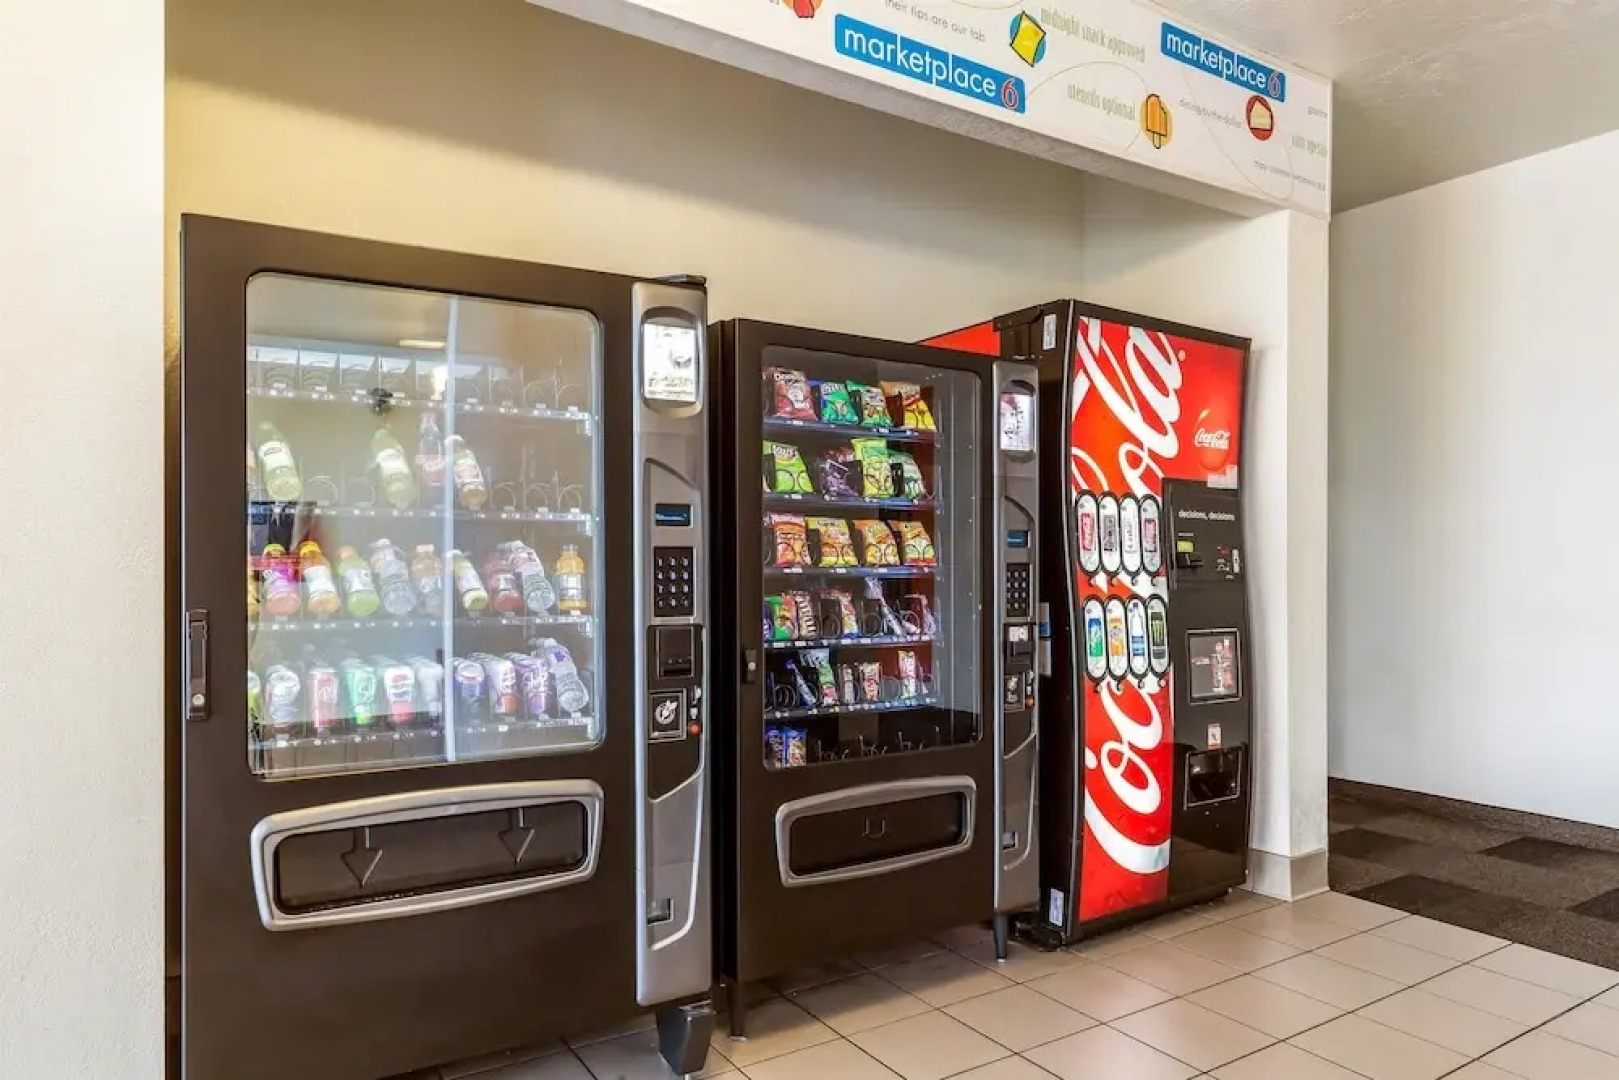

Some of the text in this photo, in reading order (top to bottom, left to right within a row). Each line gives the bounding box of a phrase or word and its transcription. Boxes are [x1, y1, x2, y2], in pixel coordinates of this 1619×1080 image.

[911, 6, 928, 21] tips
[931, 15, 948, 29] are
[951, 23, 967, 35] our
[970, 27, 985, 42] tab
[844, 28, 1020, 110] marketplace 6
[1166, 33, 1282, 98] marketplace 6
